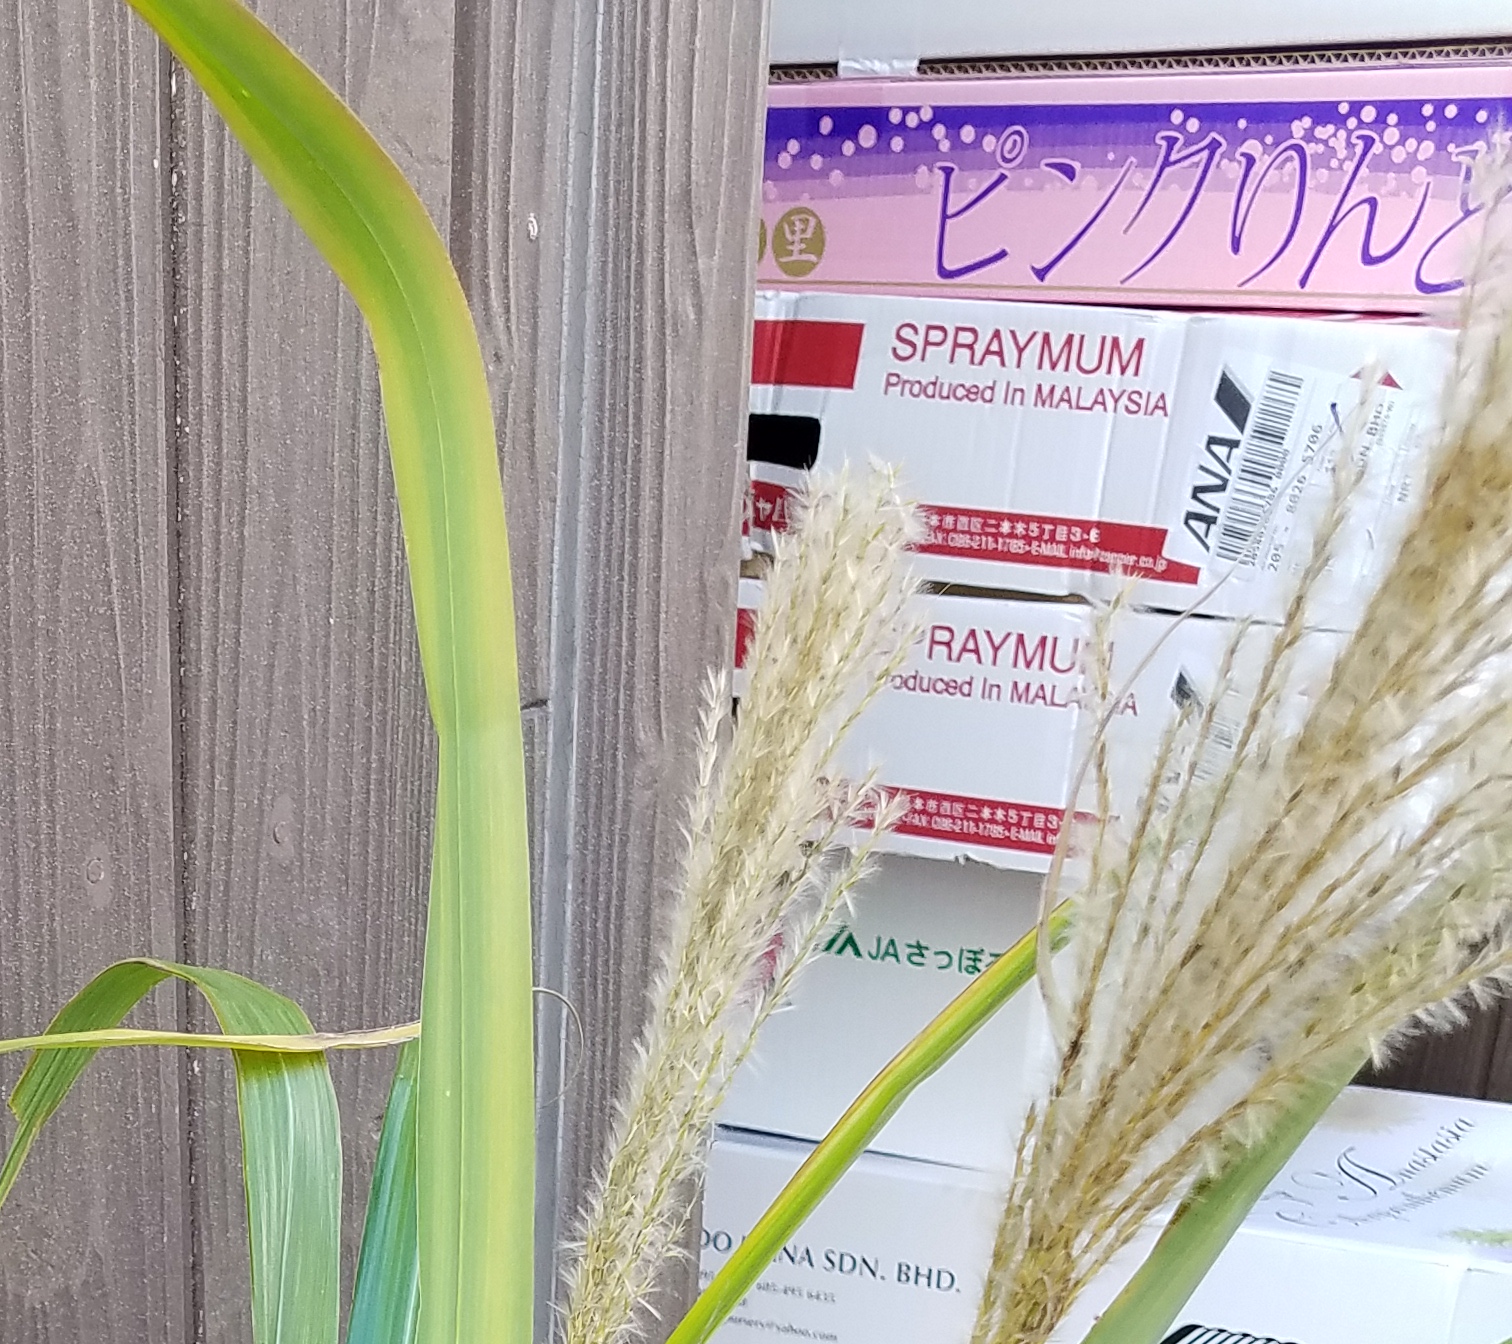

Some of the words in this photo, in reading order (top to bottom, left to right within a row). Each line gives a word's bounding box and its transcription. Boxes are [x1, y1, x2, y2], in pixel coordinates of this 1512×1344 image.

[891, 322, 1146, 377] SPRAYMUM
[884, 372, 997, 404] Produced
[1003, 380, 1025, 406] In
[1034, 383, 1169, 417] MALAYSIA
[1183, 434, 1241, 554] ANA
[916, 623, 1114, 676] RAYMU
[890, 669, 974, 698] oduced
[896, 1262, 962, 1294] BHD.
